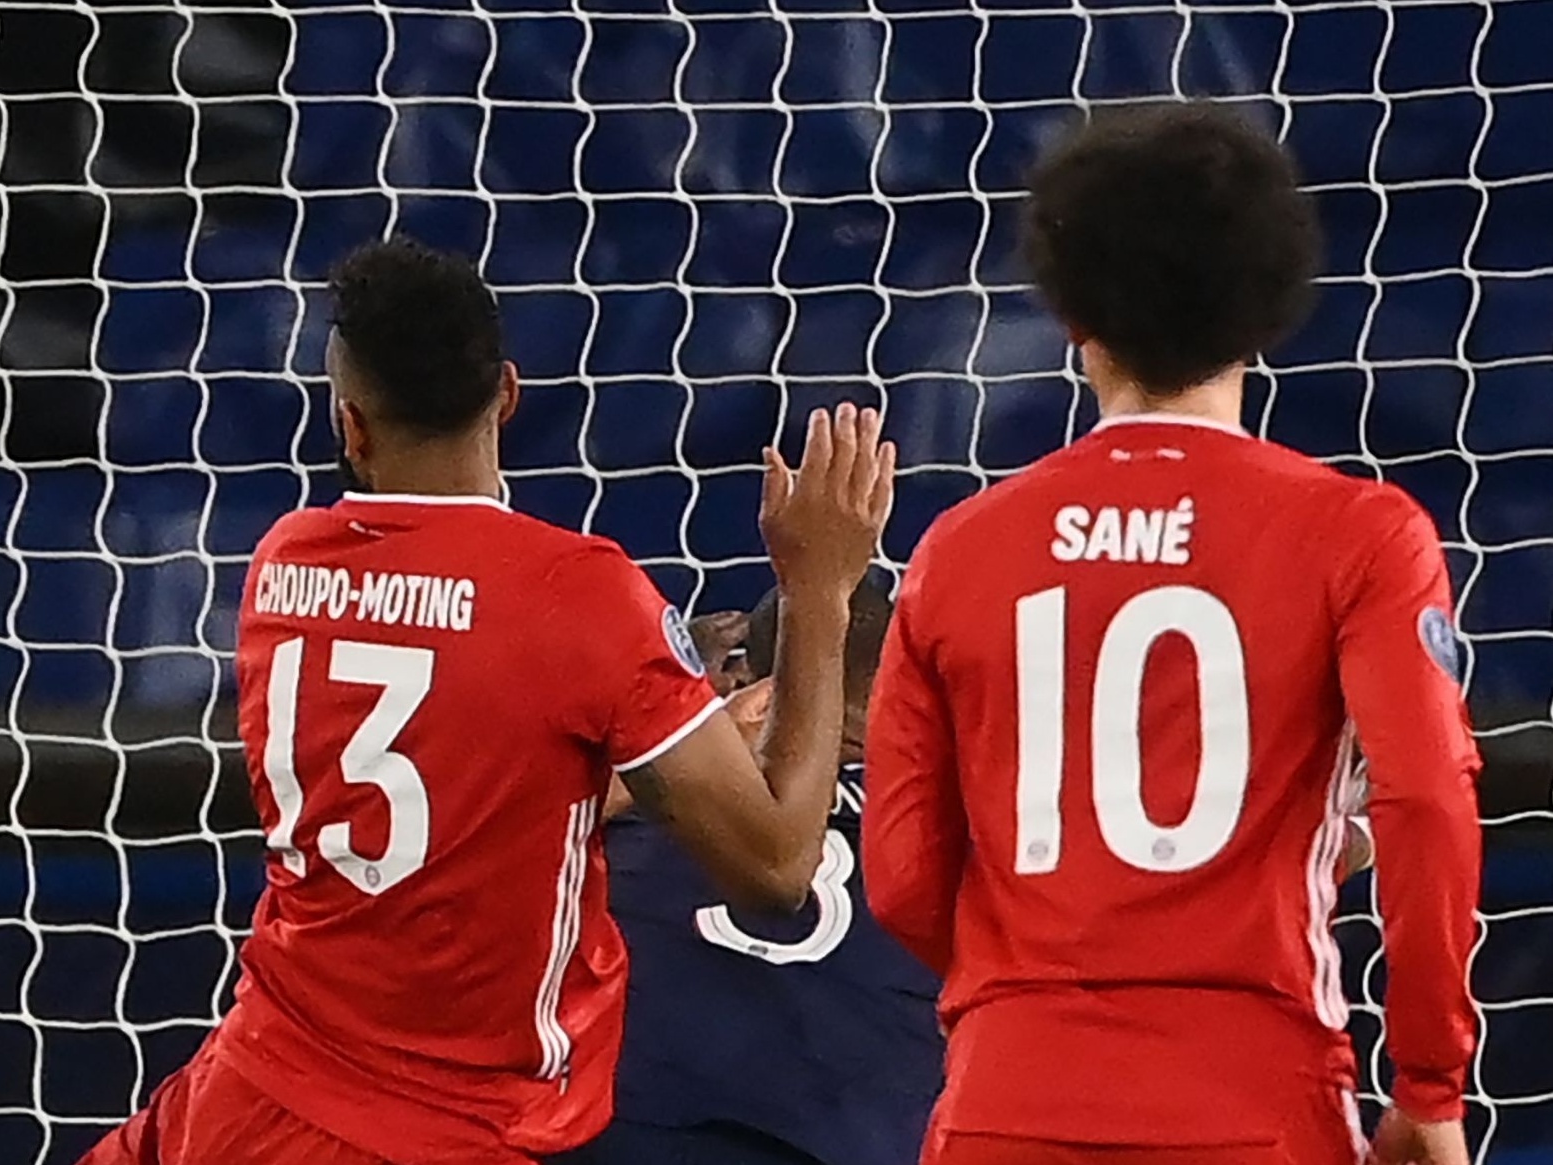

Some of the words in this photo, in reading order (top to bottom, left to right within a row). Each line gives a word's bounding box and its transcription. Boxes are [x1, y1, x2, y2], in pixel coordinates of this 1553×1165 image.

[254, 562, 476, 631] CHOUPO-MOTING
[1052, 496, 1194, 564] SANÉ
[263, 636, 435, 896] 13
[1015, 584, 1251, 875] 10
